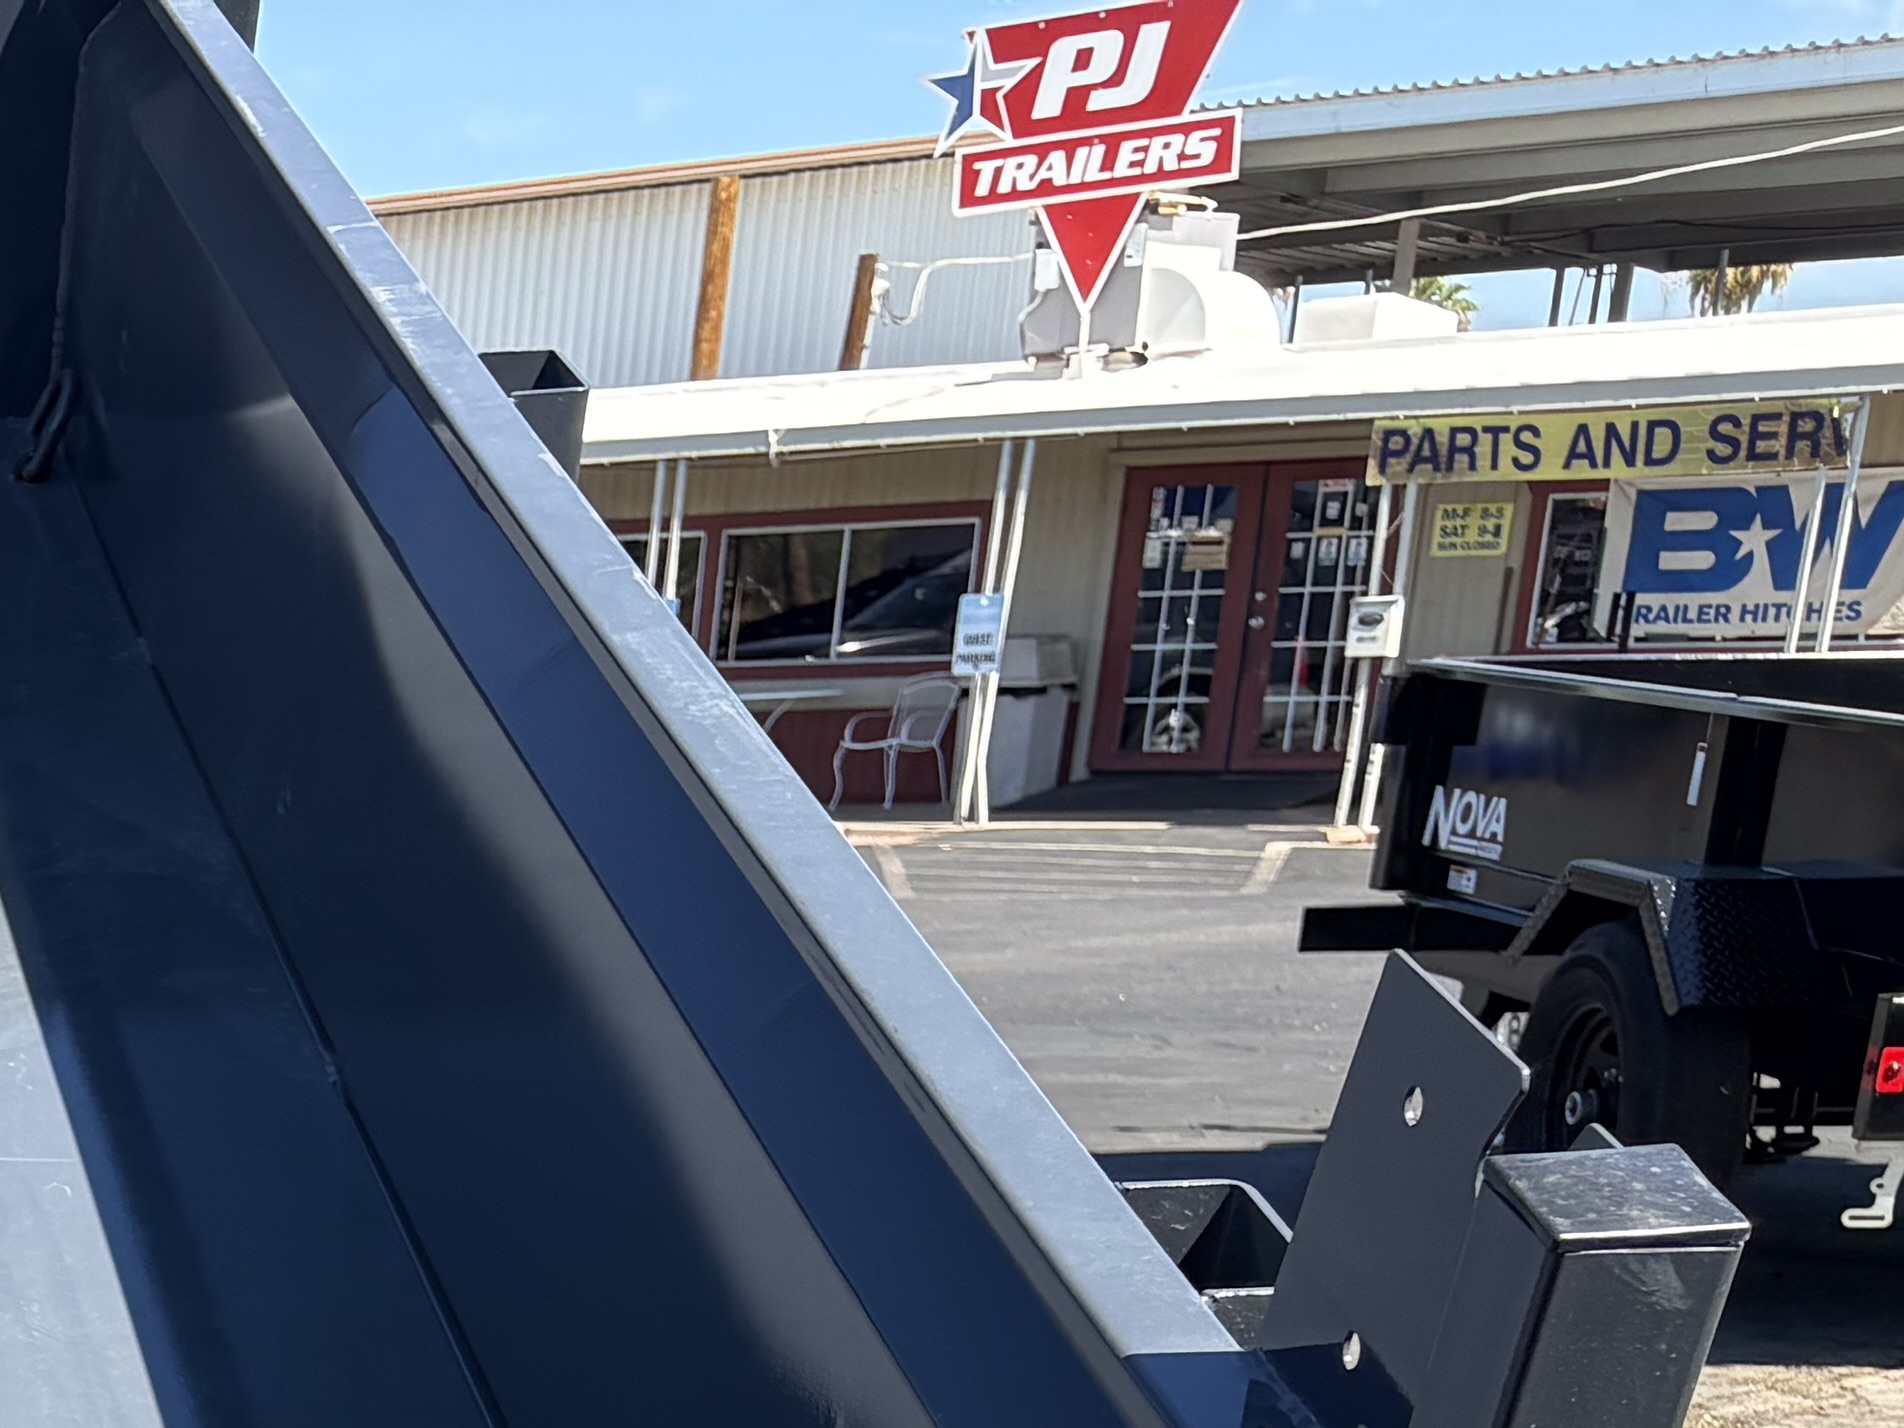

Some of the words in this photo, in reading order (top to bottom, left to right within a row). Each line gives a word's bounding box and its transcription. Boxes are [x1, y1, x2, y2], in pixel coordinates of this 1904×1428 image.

[1031, 21, 1171, 120] PJ
[972, 127, 1223, 197] TRAILERS
[1378, 423, 1542, 475] PARTS
[1562, 418, 1682, 469] AND
[1632, 603, 1733, 625] RAILER
[1421, 784, 1507, 850] NOVA
